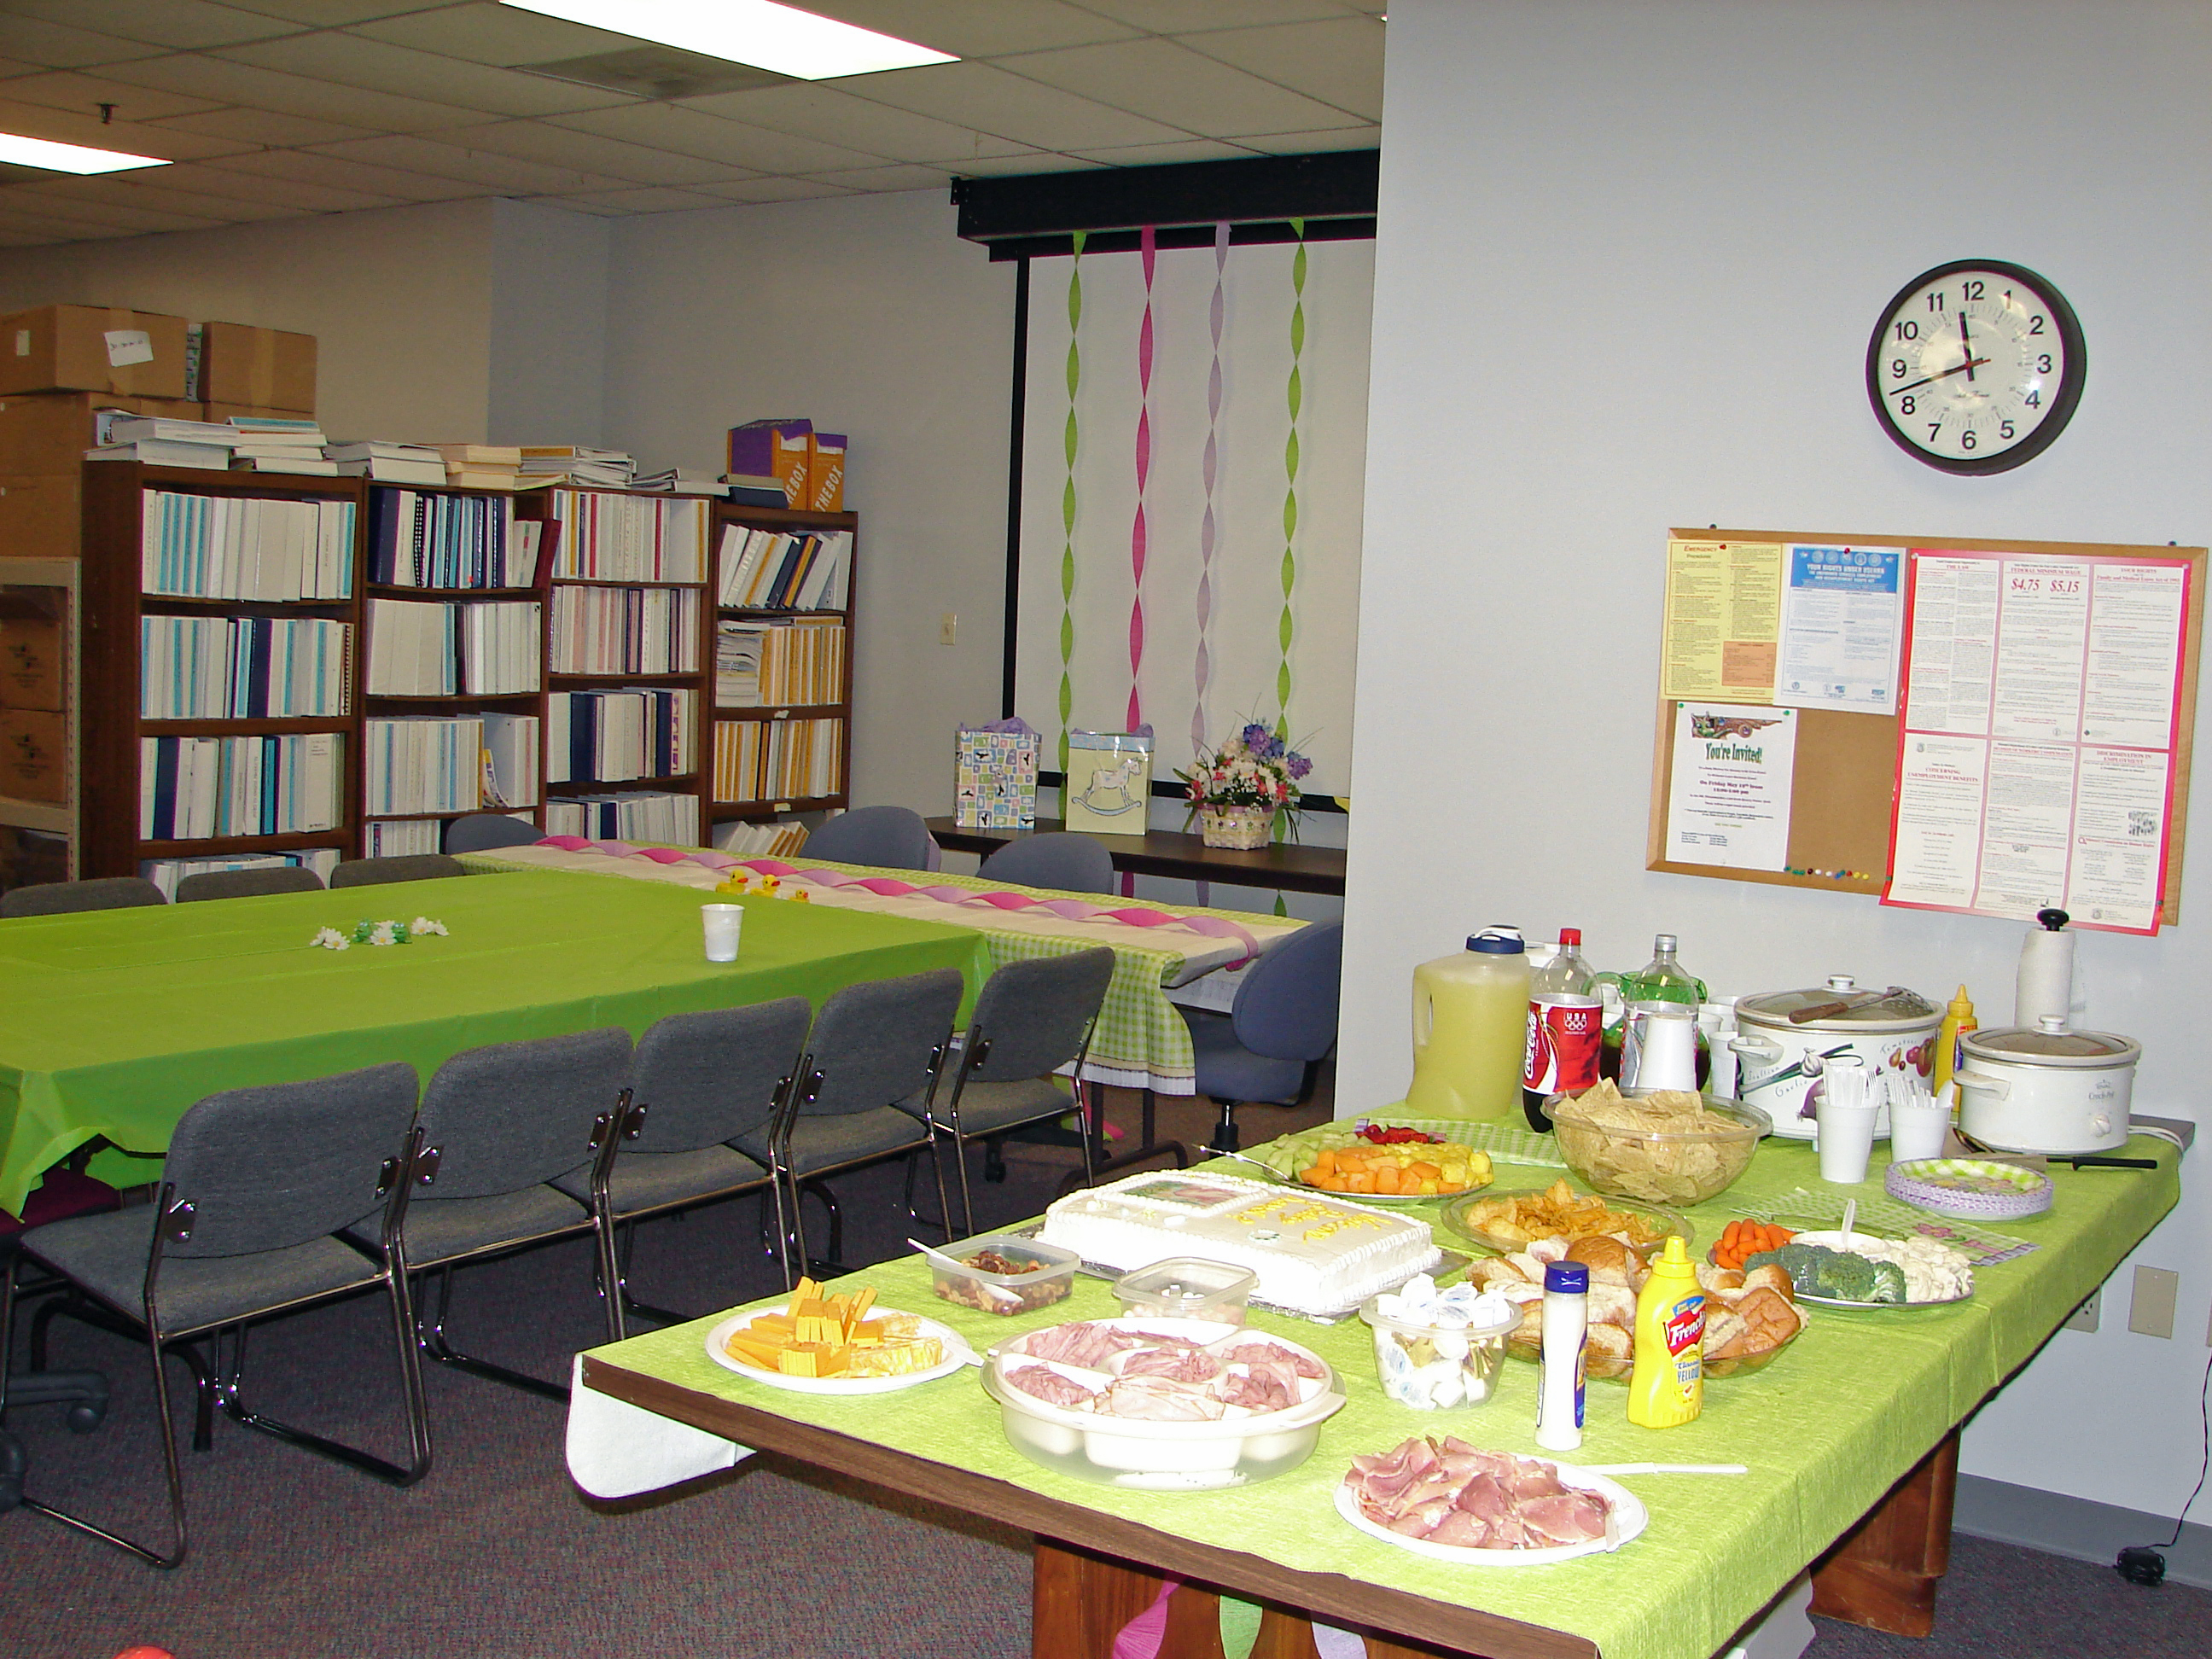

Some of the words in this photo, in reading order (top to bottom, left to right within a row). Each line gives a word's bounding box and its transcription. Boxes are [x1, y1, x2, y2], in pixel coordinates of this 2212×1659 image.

[1962, 281, 1984, 301] 12
[2003, 290, 2011, 310] 1
[1927, 293, 1944, 311] 11
[1895, 321, 1918, 341] 10
[2029, 315, 2044, 335] 2
[1892, 359, 1906, 378] 9
[2037, 354, 2052, 374] 3
[1901, 396, 1916, 415] 8
[2024, 390, 2040, 409] 4
[1927, 423, 1941, 442] 7
[2000, 420, 2014, 439] 5
[1962, 431, 1976, 450] 6
[2011, 578, 2040, 591] $4.75
[2049, 579, 2080, 592] $5.15
[1706, 742, 1731, 760] You're
[1732, 742, 1762, 764] Invited!
